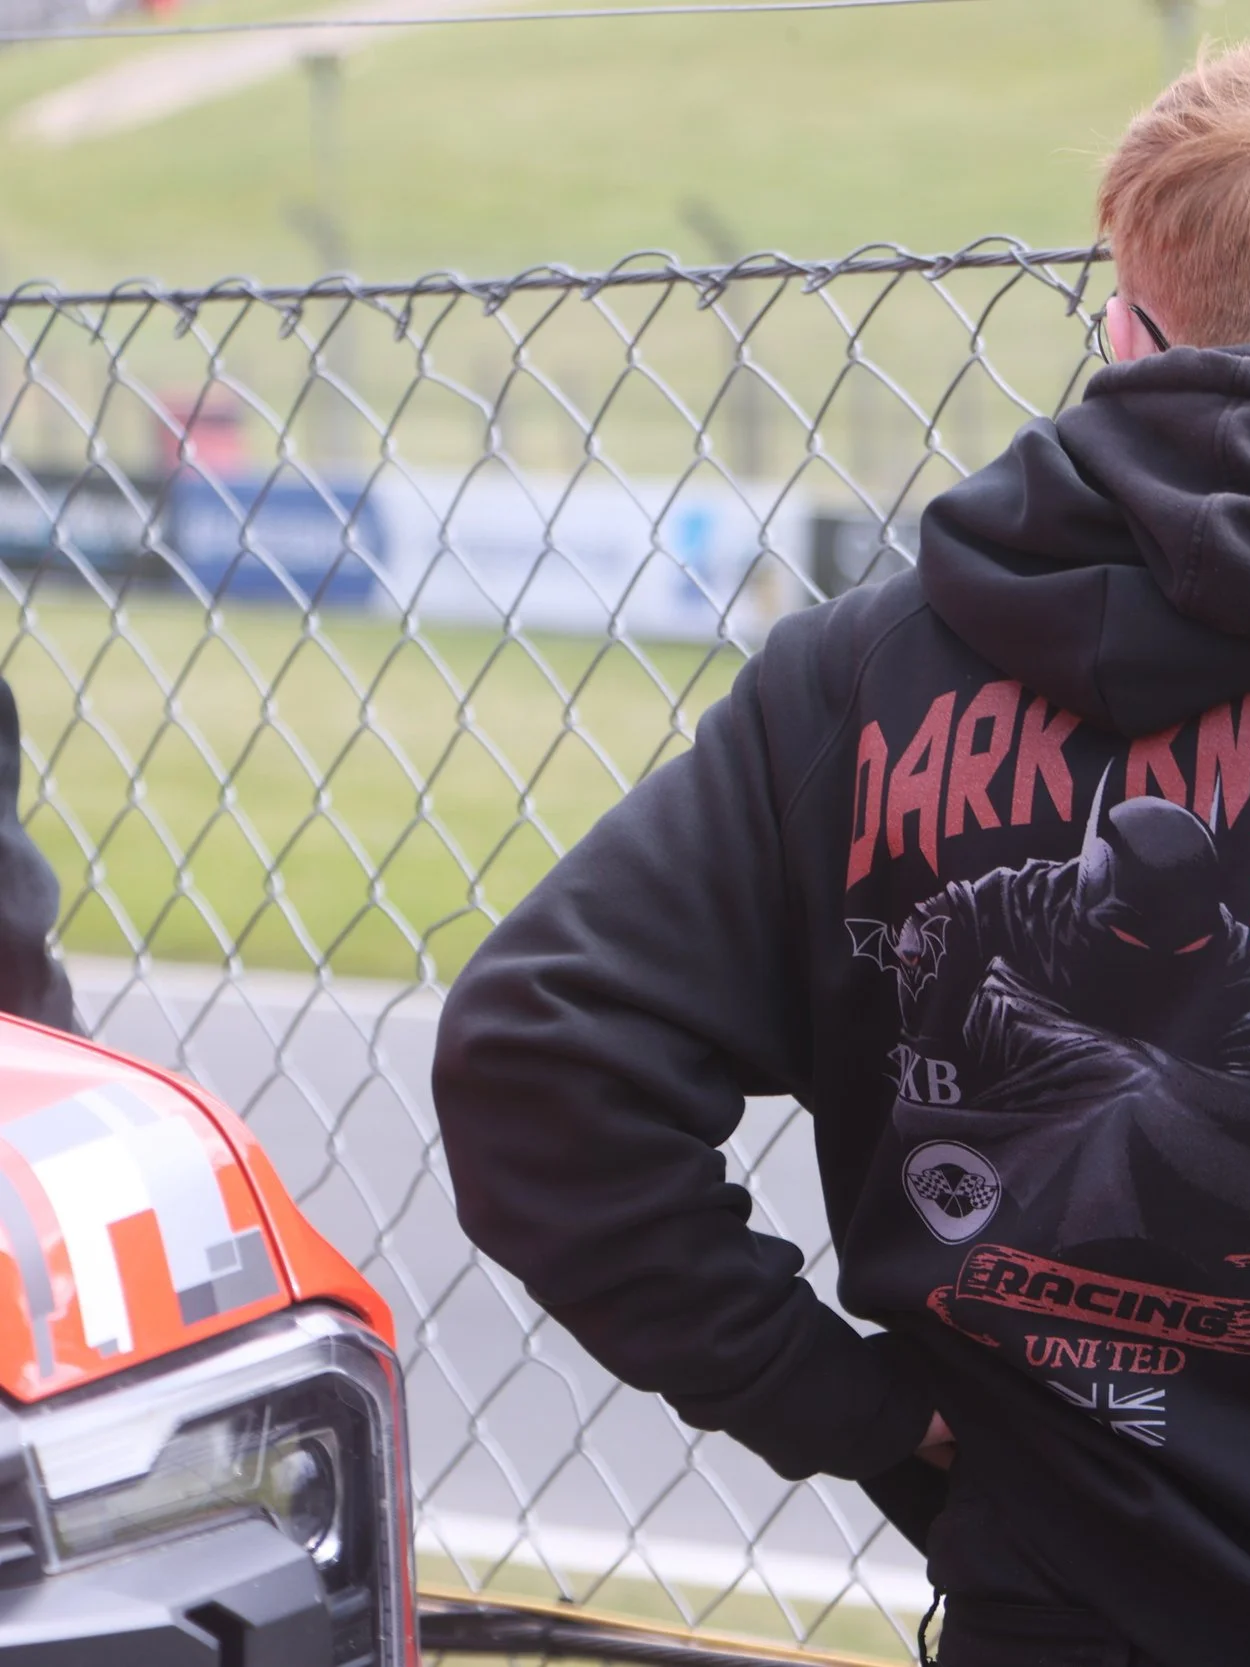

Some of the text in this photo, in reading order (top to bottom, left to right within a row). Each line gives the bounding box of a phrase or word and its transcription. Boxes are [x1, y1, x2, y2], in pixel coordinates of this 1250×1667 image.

[846, 680, 1082, 893] DARK
[986, 1259, 1236, 1339] RACING
[1023, 1334, 1187, 1376] UNITED
